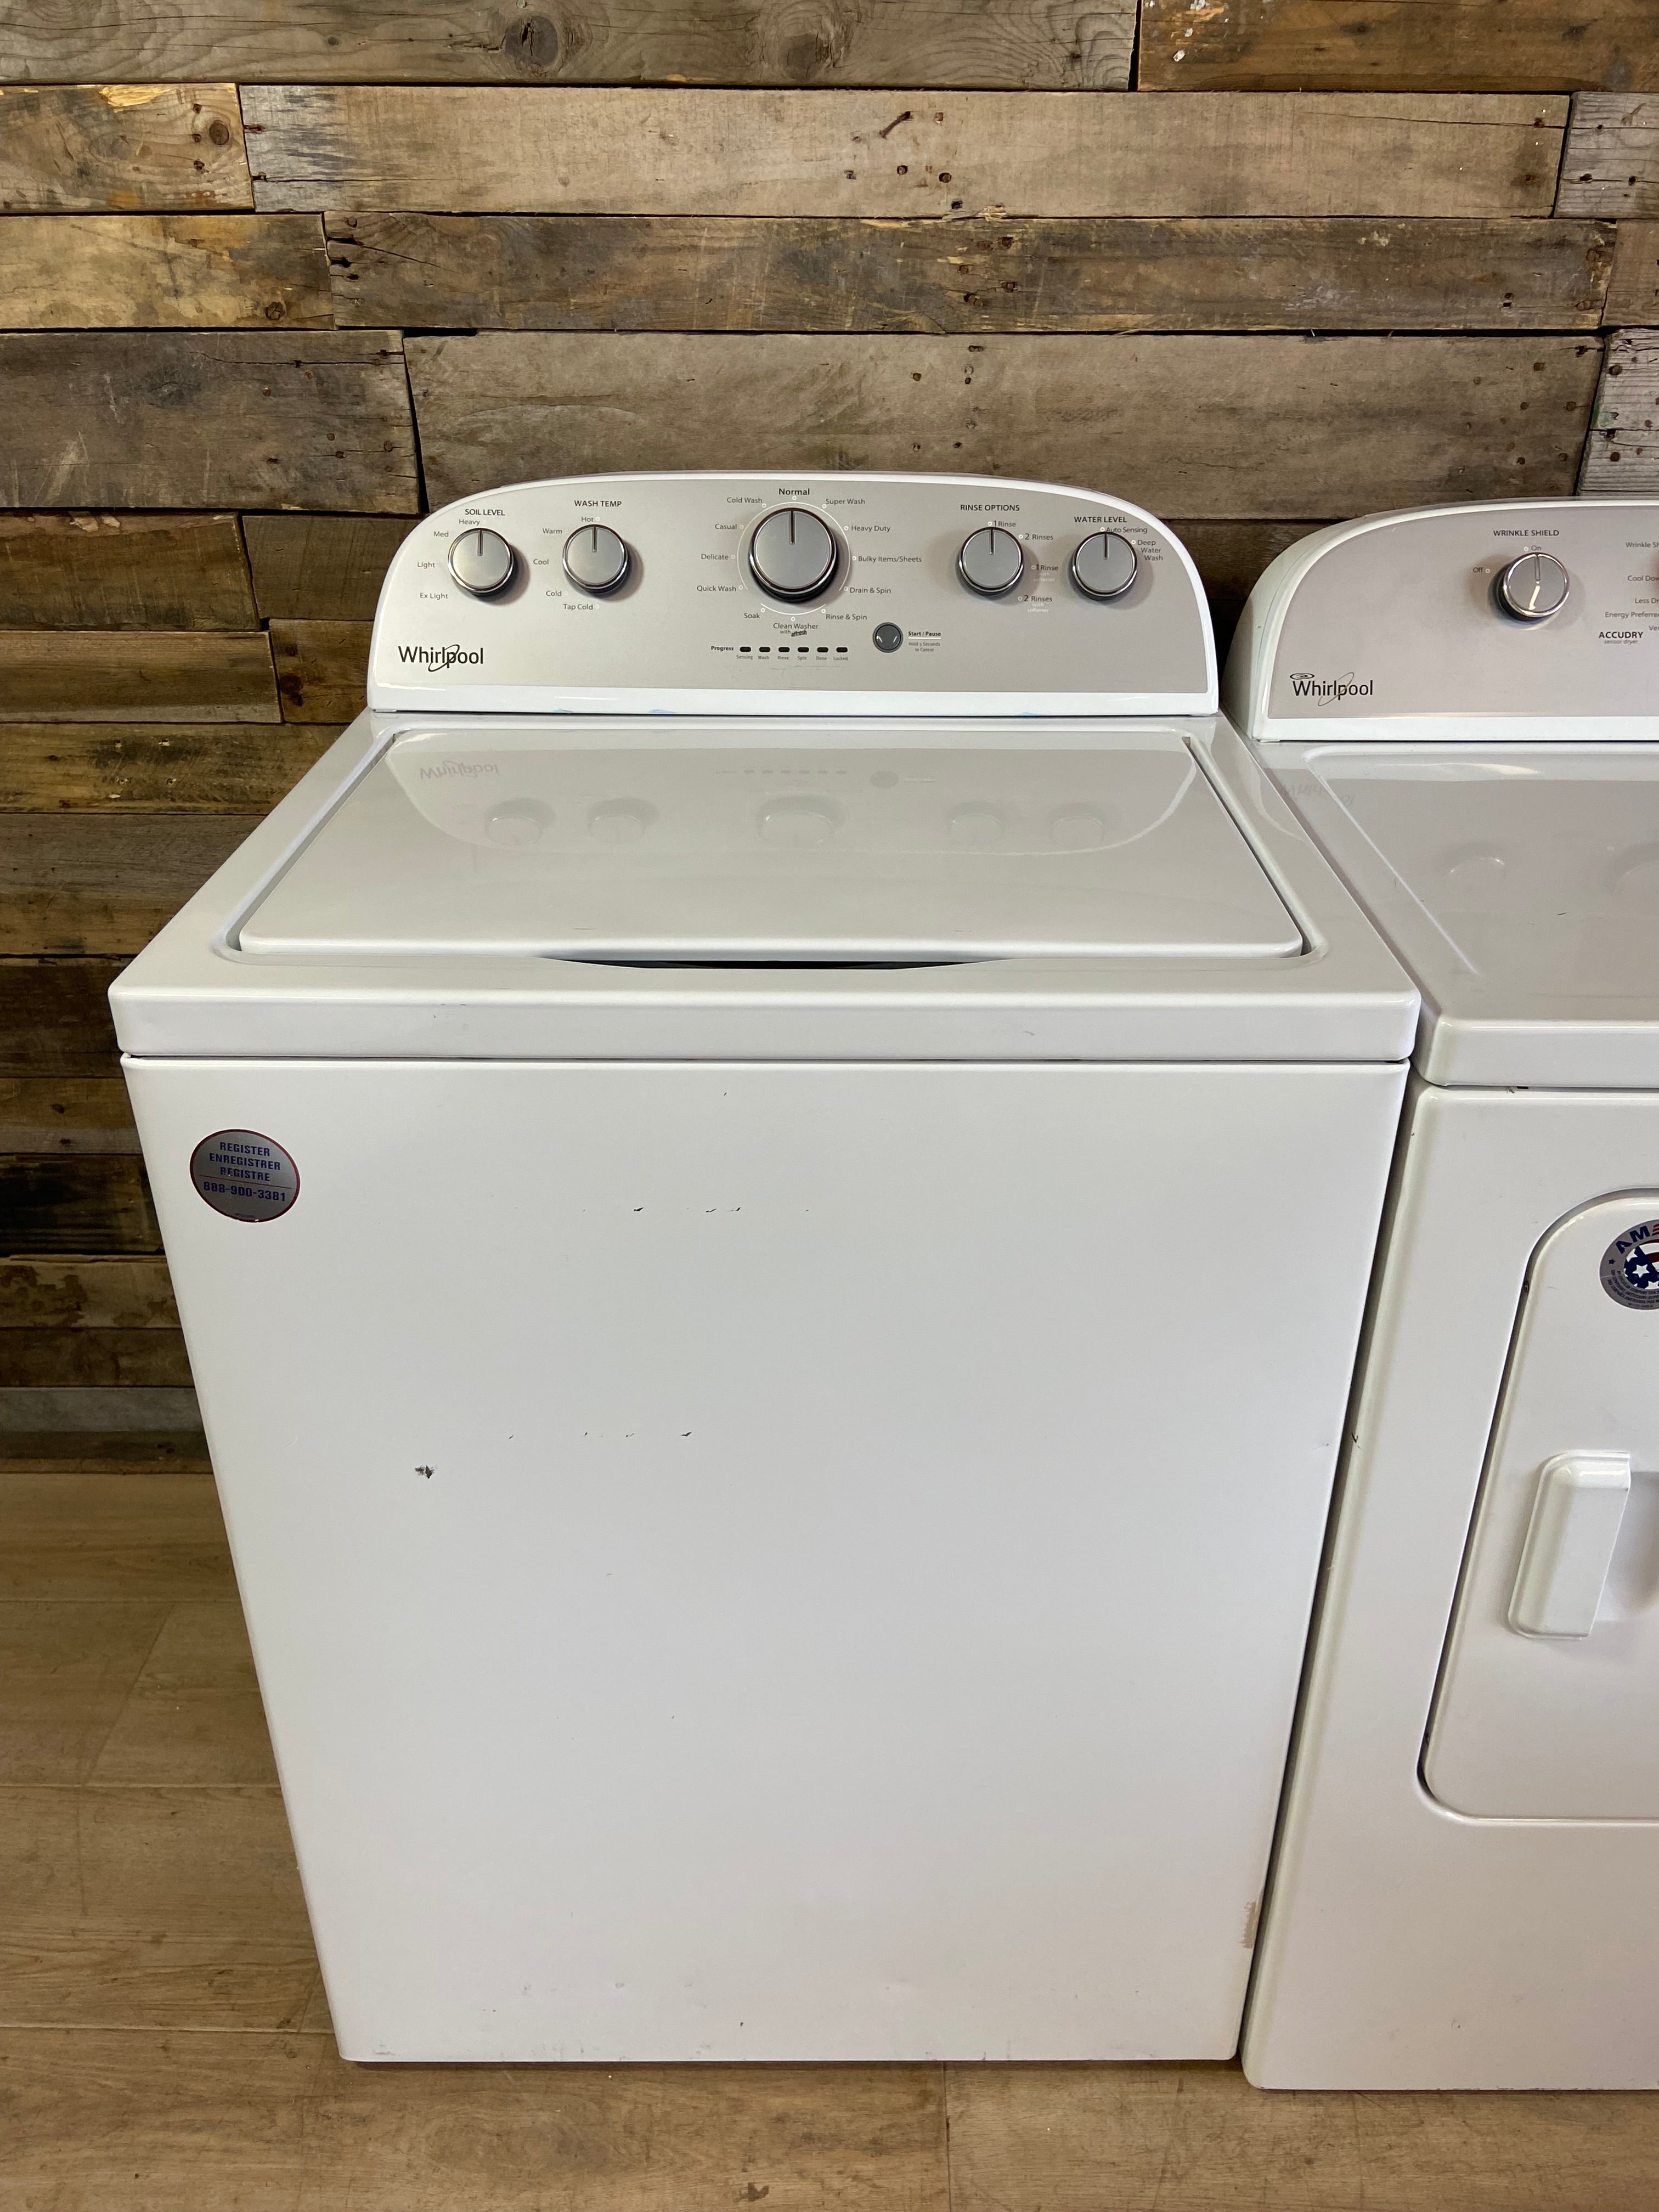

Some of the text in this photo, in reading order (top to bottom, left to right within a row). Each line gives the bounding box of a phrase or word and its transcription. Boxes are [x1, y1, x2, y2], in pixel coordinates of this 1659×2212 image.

[398, 645, 484, 670] Whirlpool
[1293, 679, 1373, 701] Whirlpool
[220, 1142, 270, 1156] REGISTER
[210, 1153, 280, 1170] ENREGISTRER
[221, 1167, 270, 1181] REGISTRE
[204, 1181, 285, 1201] 888-900-3381
